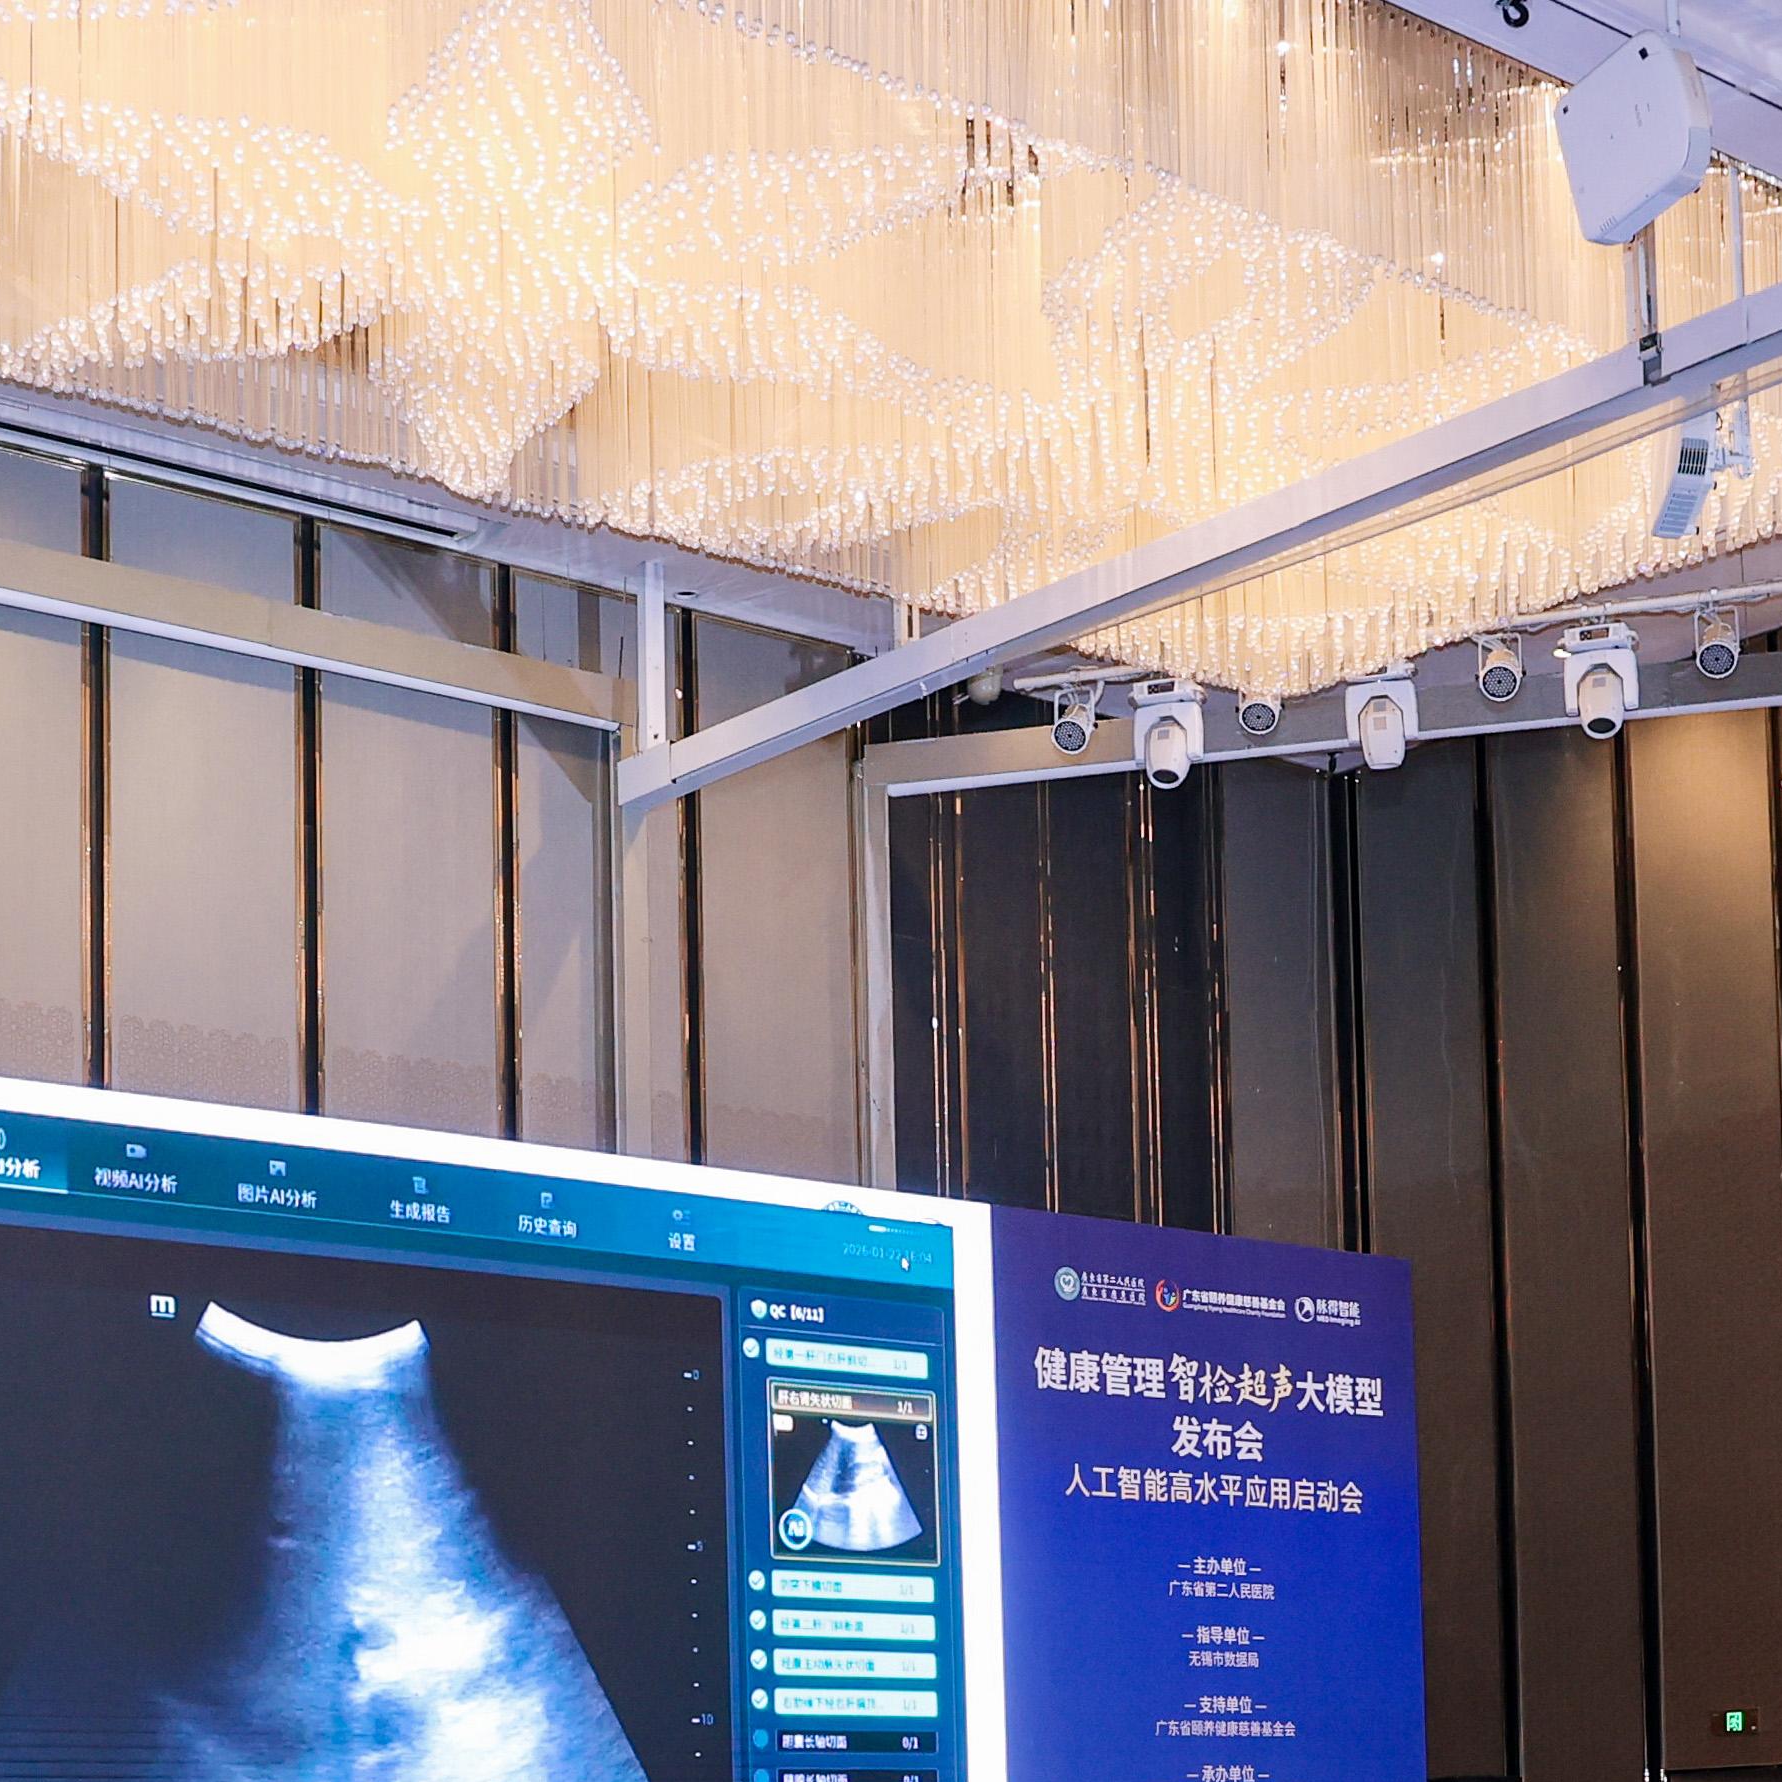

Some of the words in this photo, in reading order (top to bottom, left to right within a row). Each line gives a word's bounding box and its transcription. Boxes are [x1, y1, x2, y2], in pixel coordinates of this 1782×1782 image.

[95, 1168, 177, 1194] 视频AI分析
[238, 1184, 317, 1209] 图片AI分析
[390, 1200, 451, 1225] 生成报告
[518, 1215, 577, 1239] 历史查询
[668, 1232, 695, 1252] 设置
[1316, 1299, 1360, 1319] 脉得智能
[1034, 1346, 1383, 1417] 健康管理智检超声大模型
[1171, 1416, 1263, 1462] 发布会
[1065, 1463, 1362, 1514] 人工智能高水平应用启动会
[1193, 1556, 1247, 1576] 主办单位
[1168, 1580, 1275, 1600] 广东省第二人民医院
[1197, 1626, 1250, 1645] 指导单位
[1188, 1651, 1259, 1668] 无锡市数据局
[1199, 1696, 1252, 1715] 支持单位
[701, 1713, 714, 1726] 10
[1155, 1720, 1295, 1737] 广东省颐养健康慈善基金会
[902, 1736, 919, 1750] 0/1
[1202, 1765, 1255, 1782] 承办单位
